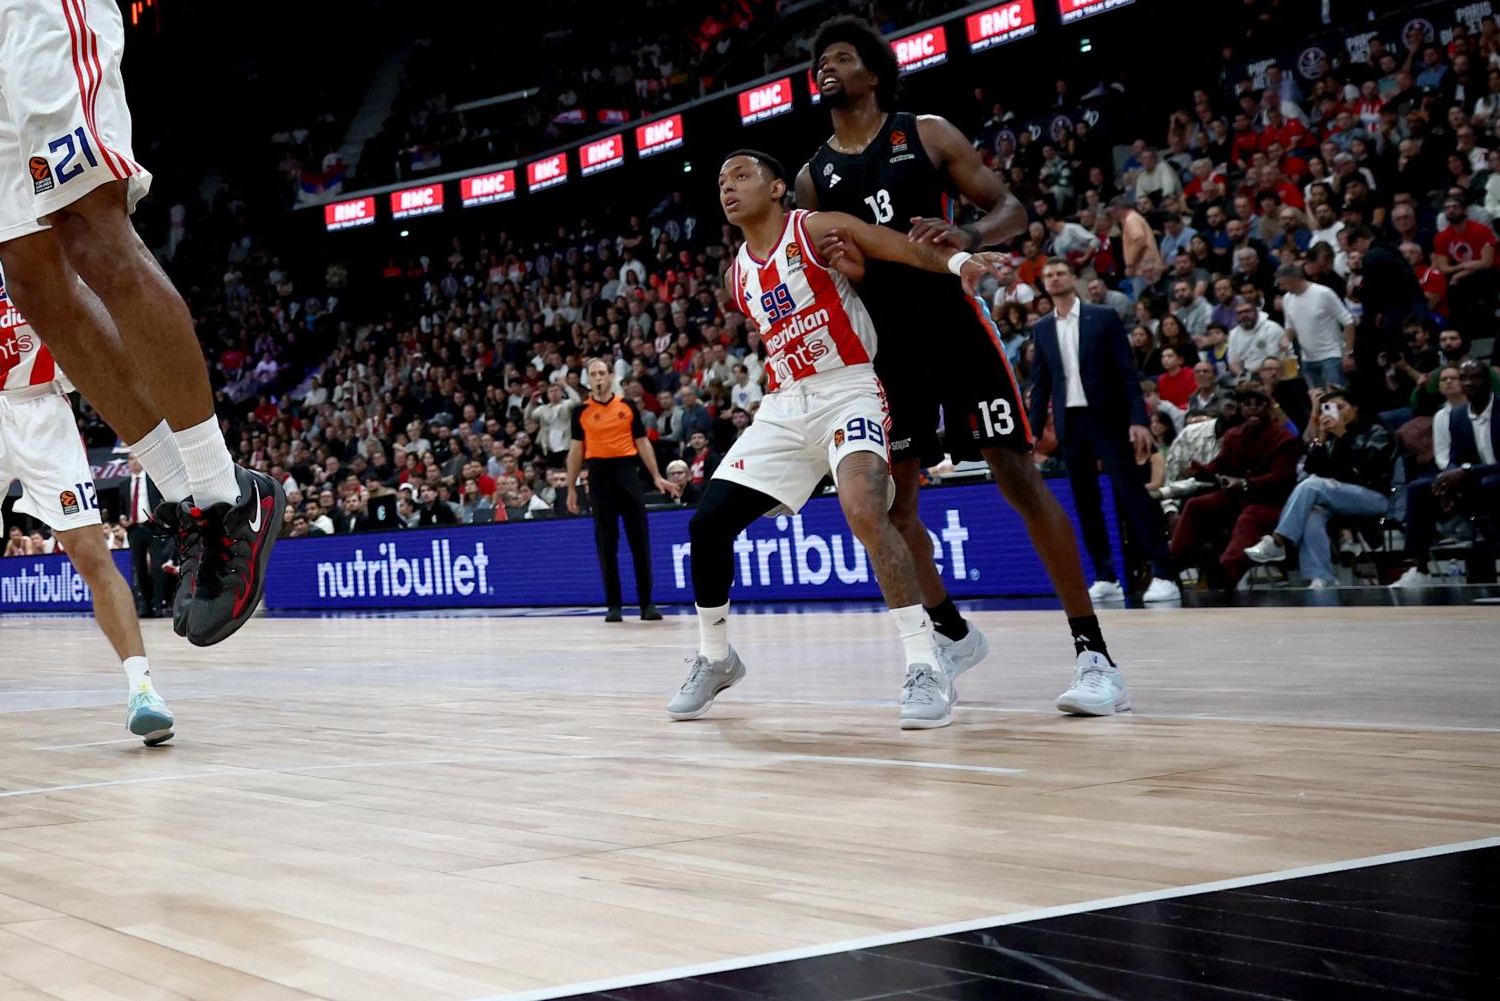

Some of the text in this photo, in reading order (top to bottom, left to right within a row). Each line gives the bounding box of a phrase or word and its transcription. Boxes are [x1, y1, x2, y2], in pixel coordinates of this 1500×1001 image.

[979, 4, 1022, 37] RMC
[896, 33, 935, 66] RMC
[749, 84, 783, 111] RMC
[644, 120, 674, 146] RMC
[48, 126, 98, 185] 21
[587, 140, 615, 164] RMC
[400, 187, 434, 210] RMC
[471, 174, 506, 197] RMC
[334, 200, 366, 222] RMC
[864, 188, 895, 225] 13
[760, 282, 797, 324] 99
[765, 308, 829, 354] meridian
[776, 338, 829, 380] mts
[846, 417, 885, 448] 99
[977, 398, 1015, 438] 13
[75, 482, 99, 510] 12
[316, 537, 489, 598] nutribullet
